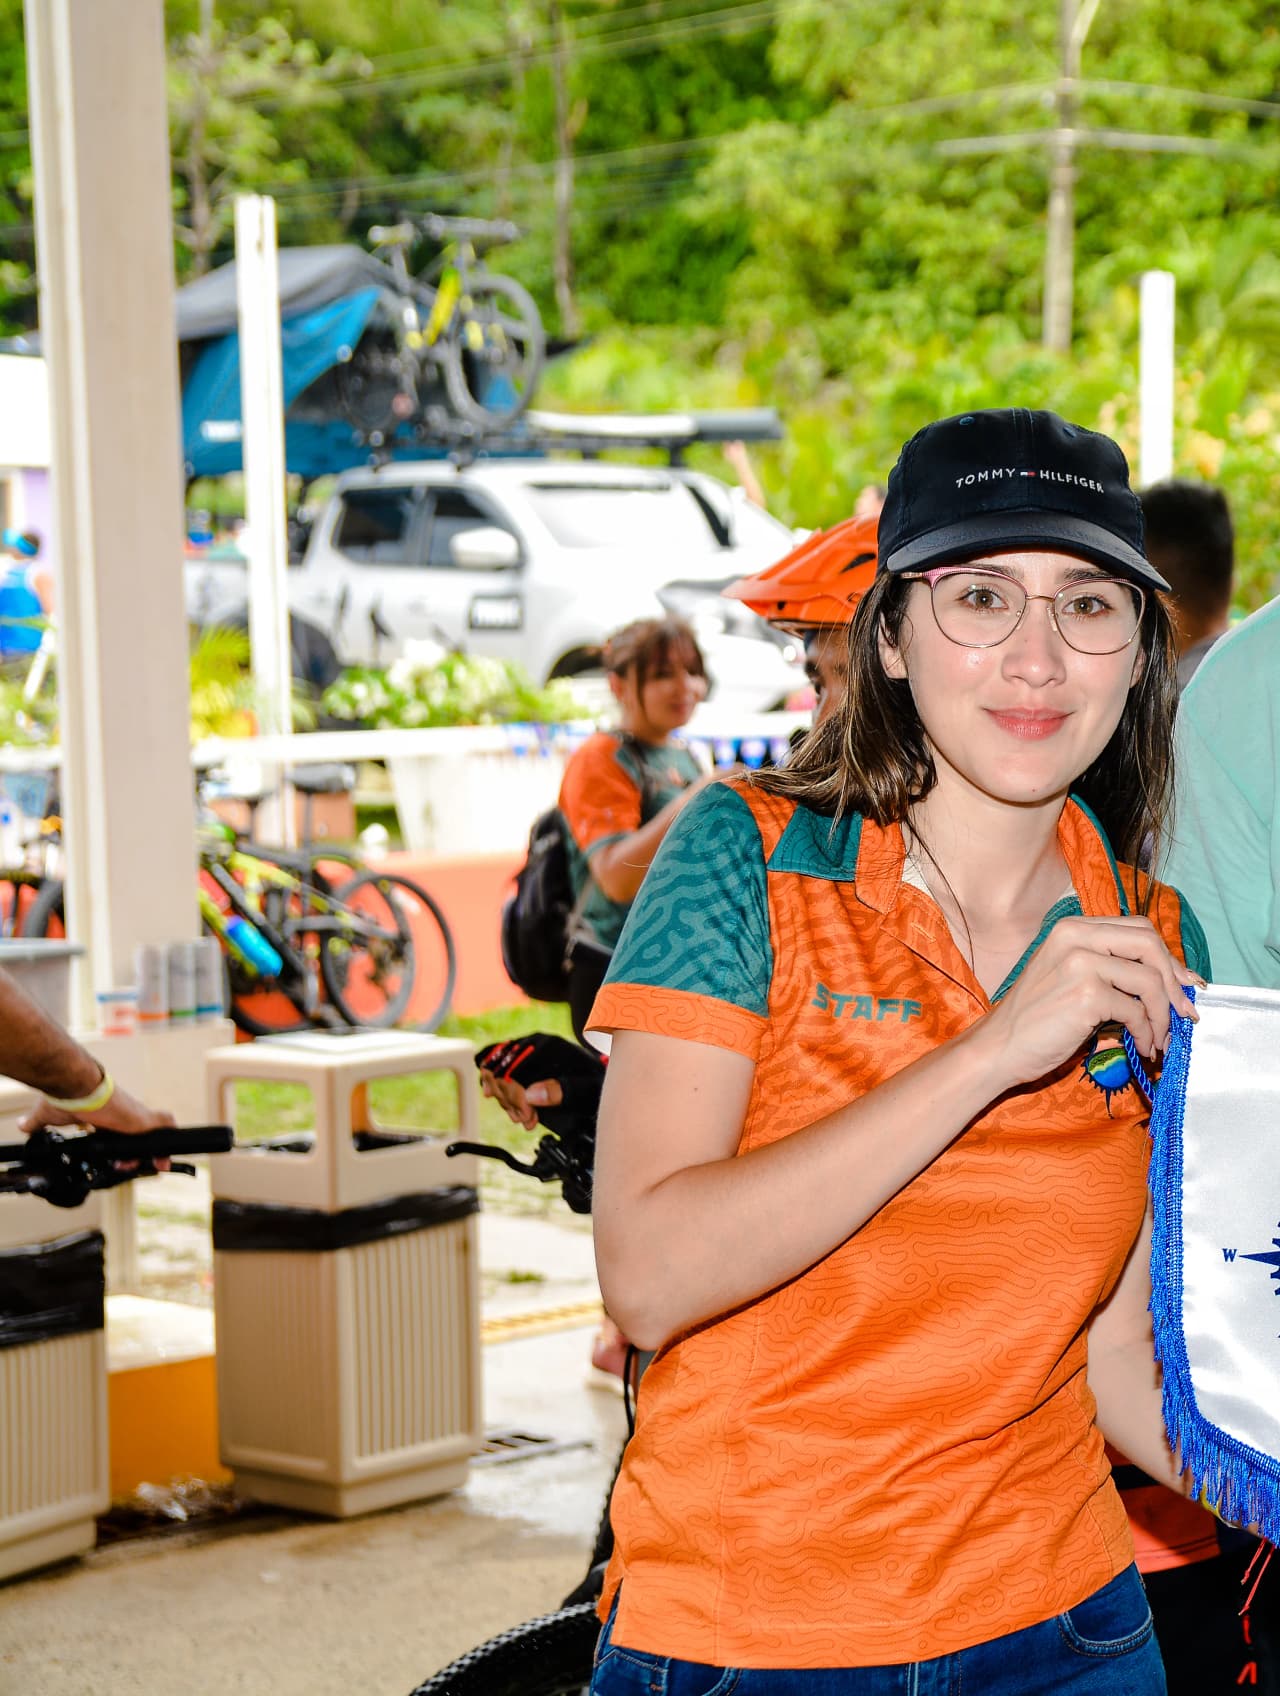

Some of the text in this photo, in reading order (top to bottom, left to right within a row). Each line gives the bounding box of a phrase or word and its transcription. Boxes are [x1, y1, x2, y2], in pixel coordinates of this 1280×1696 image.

[955, 468, 1105, 494] TOMMY HILFIGER
[811, 981, 922, 1024] STAFF
[1222, 1248, 1238, 1262] W
